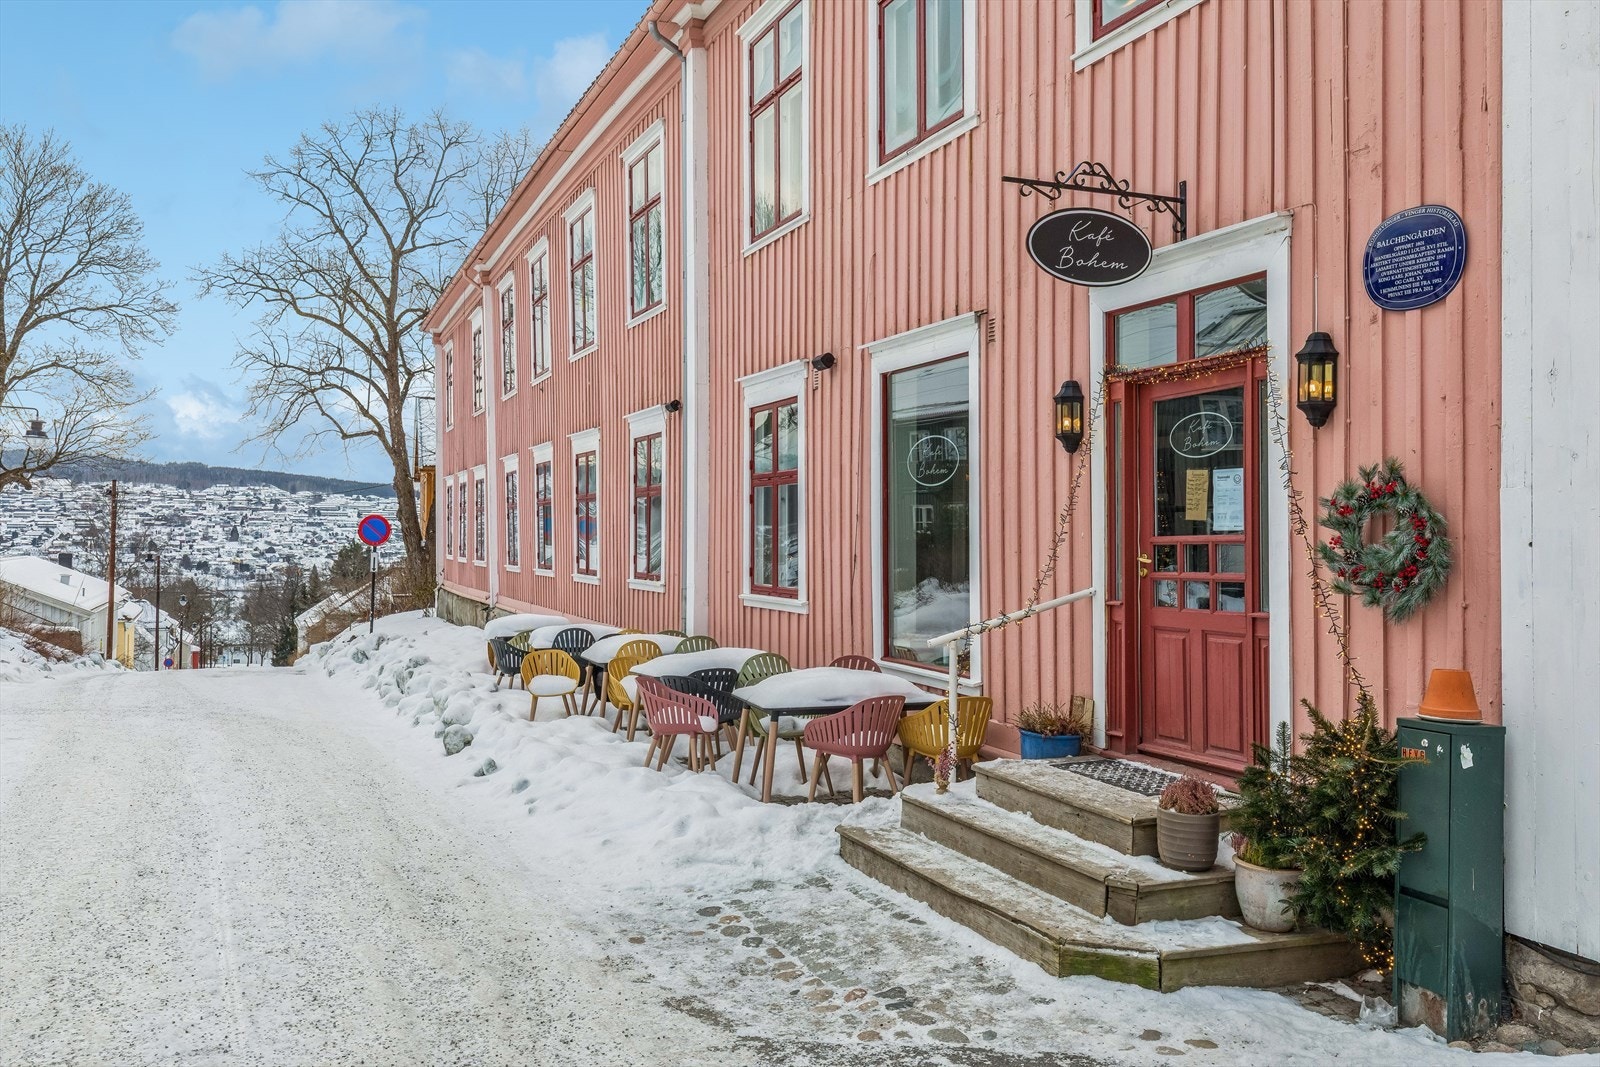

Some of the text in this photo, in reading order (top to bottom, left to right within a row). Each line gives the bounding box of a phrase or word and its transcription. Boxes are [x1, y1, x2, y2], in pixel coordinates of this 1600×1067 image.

[1404, 208, 1426, 217] VINGER
[1426, 207, 1460, 228] HISTORIELAG
[1069, 220, 1114, 247] Kafé
[1376, 226, 1446, 249] BALCHENGÅRDEN
[1055, 245, 1128, 270] Bohem
[1374, 249, 1408, 262] HANDELSGÅRD
[1411, 246, 1426, 254] LOUIS
[1437, 246, 1455, 254] RAMM
[1375, 263, 1398, 273] LASARETT
[1399, 259, 1416, 267] UNDER
[1416, 255, 1436, 264] KRIGEN
[1423, 266, 1440, 274] OSCAR
[1387, 291, 1403, 299] PRIVAT
[1182, 436, 1220, 452] Bohem
[917, 461, 948, 478] Bohem
